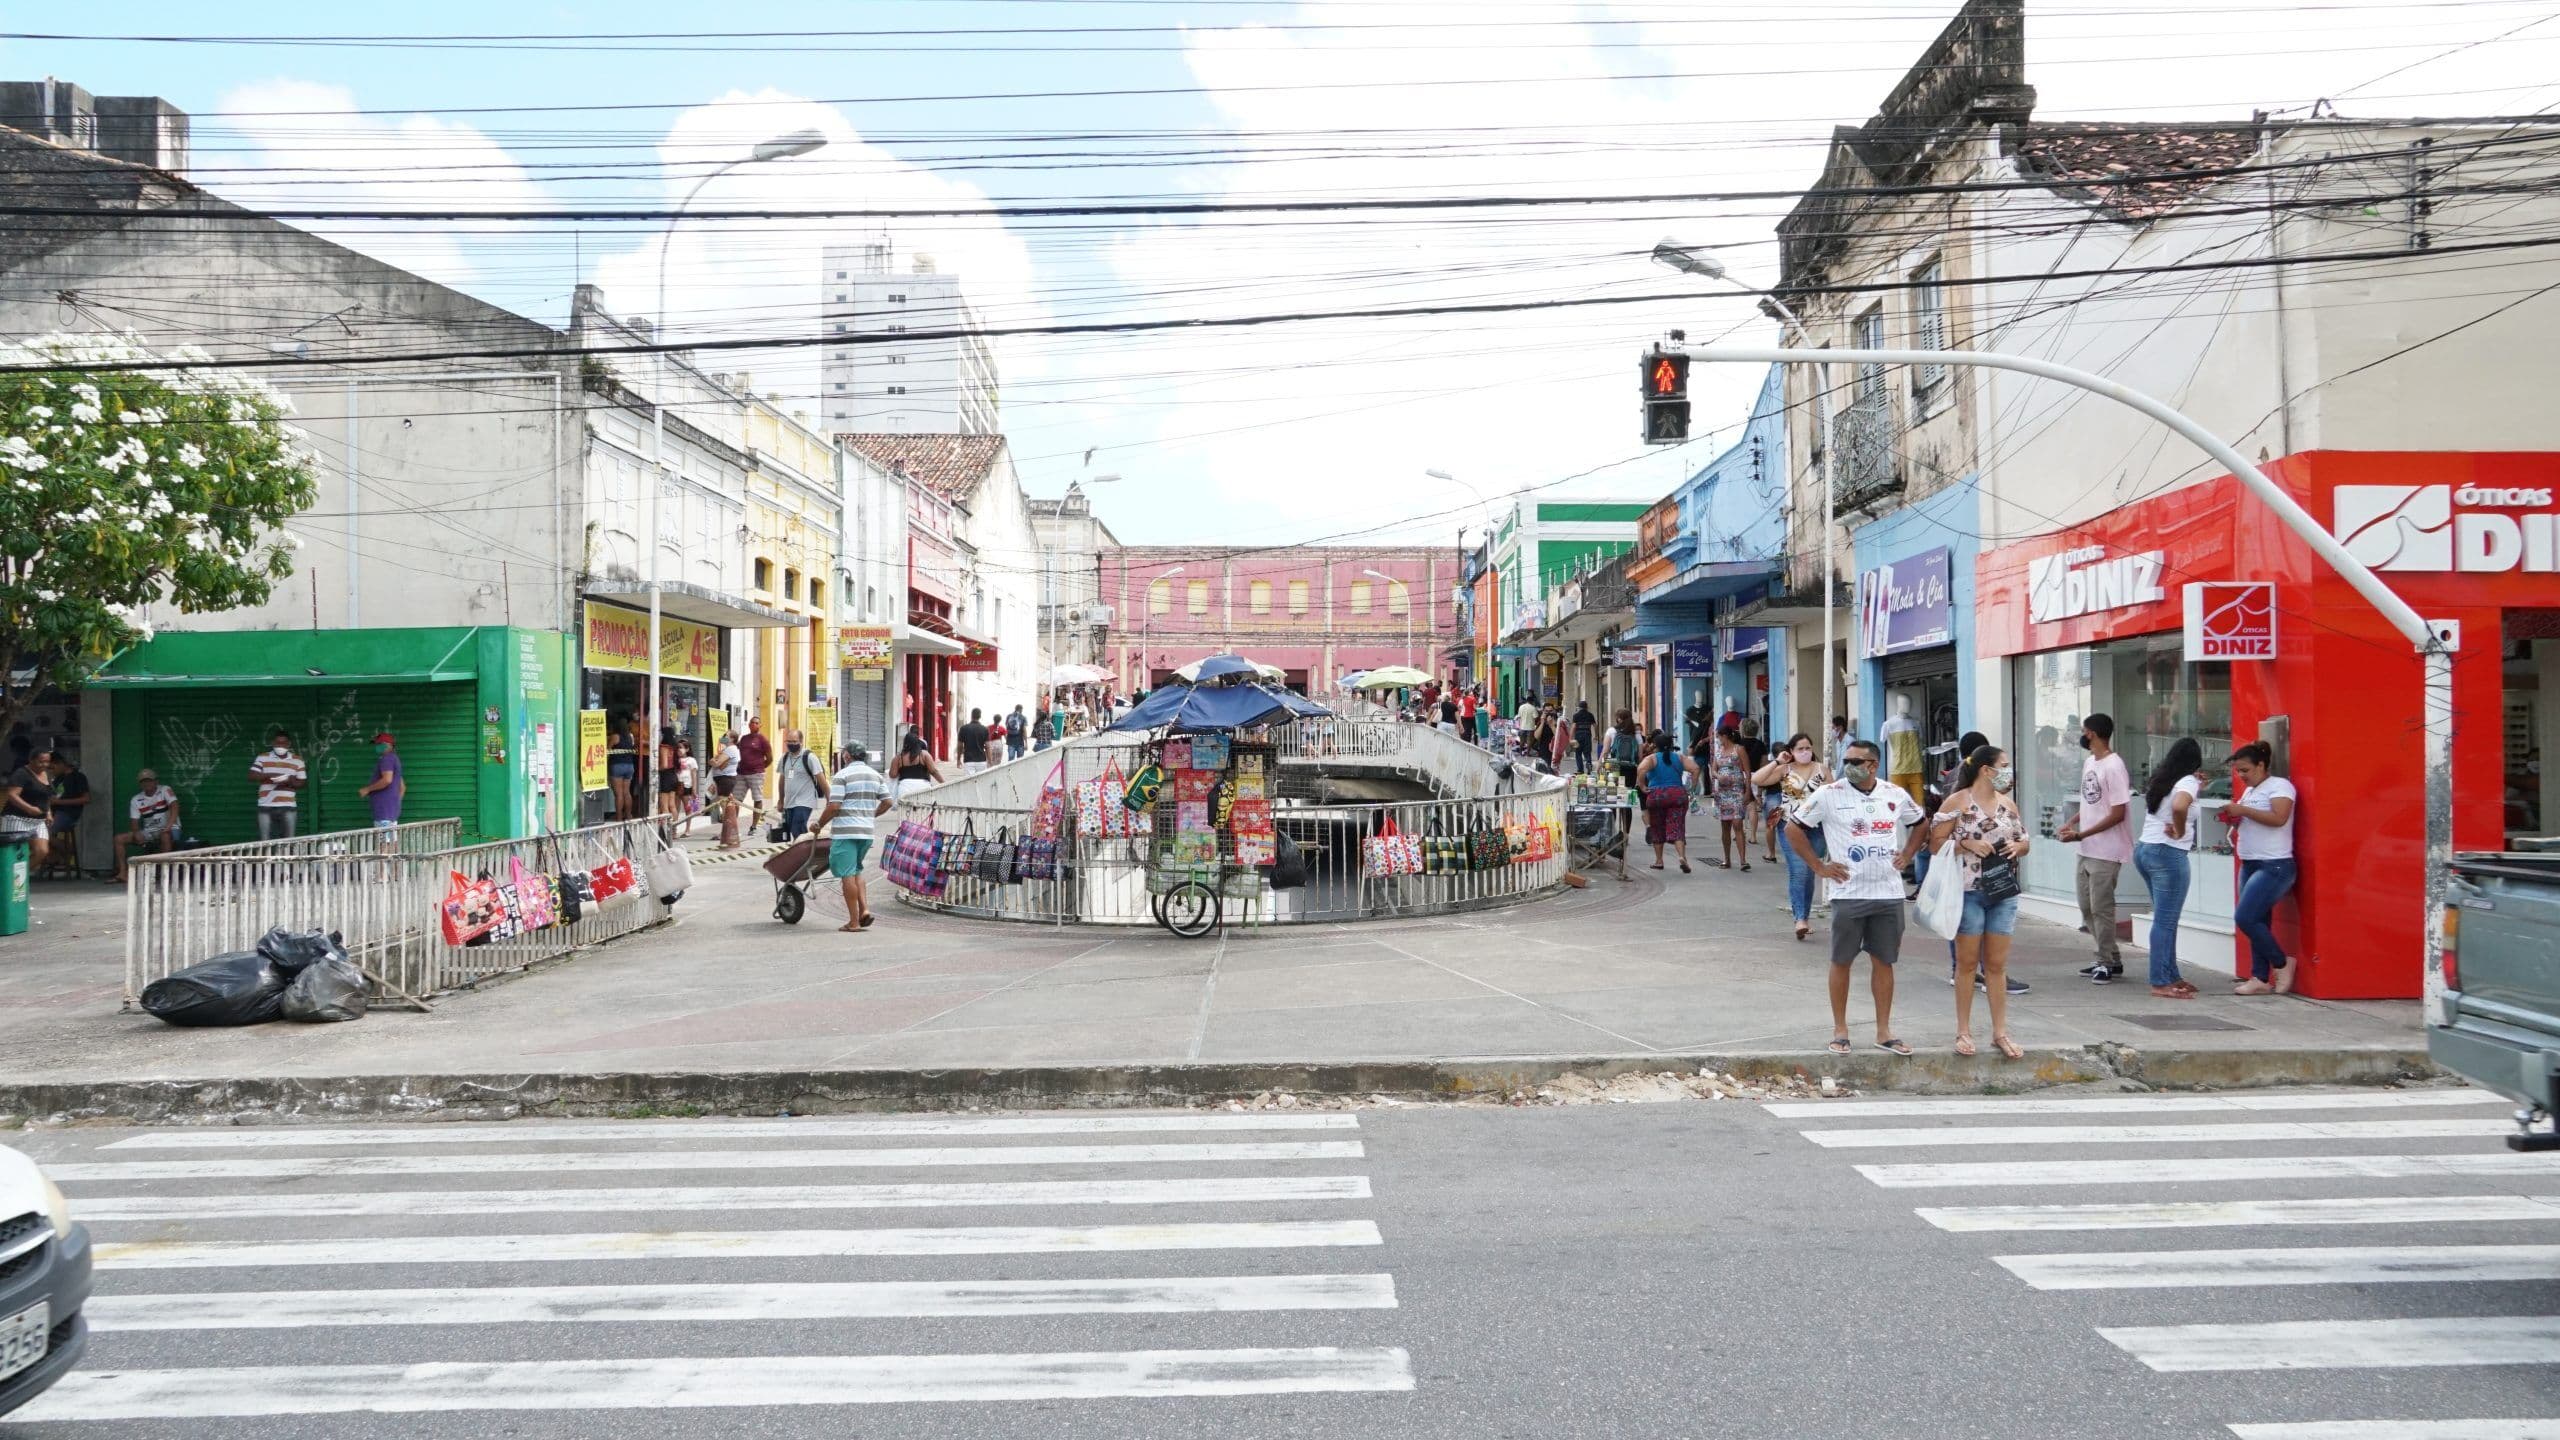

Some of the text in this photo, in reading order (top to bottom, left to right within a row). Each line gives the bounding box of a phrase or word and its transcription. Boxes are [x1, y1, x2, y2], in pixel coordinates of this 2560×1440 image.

[2454, 482, 2553, 507] ÓTICAS
[2455, 513, 2560, 573] DI
[2065, 545, 2105, 566] ÓTICAS
[1890, 575, 1944, 612] Moda & Cia
[2065, 550, 2165, 617] DINIZ
[589, 617, 649, 667] PROMOÇÃO
[660, 626, 685, 649] LICULA
[841, 628, 859, 638] FOTO
[1676, 648, 1698, 657] Moda
[2203, 639, 2272, 655] DINIZ
[1695, 656, 1709, 665] Cia
[1872, 821, 1894, 829] JOÃO
